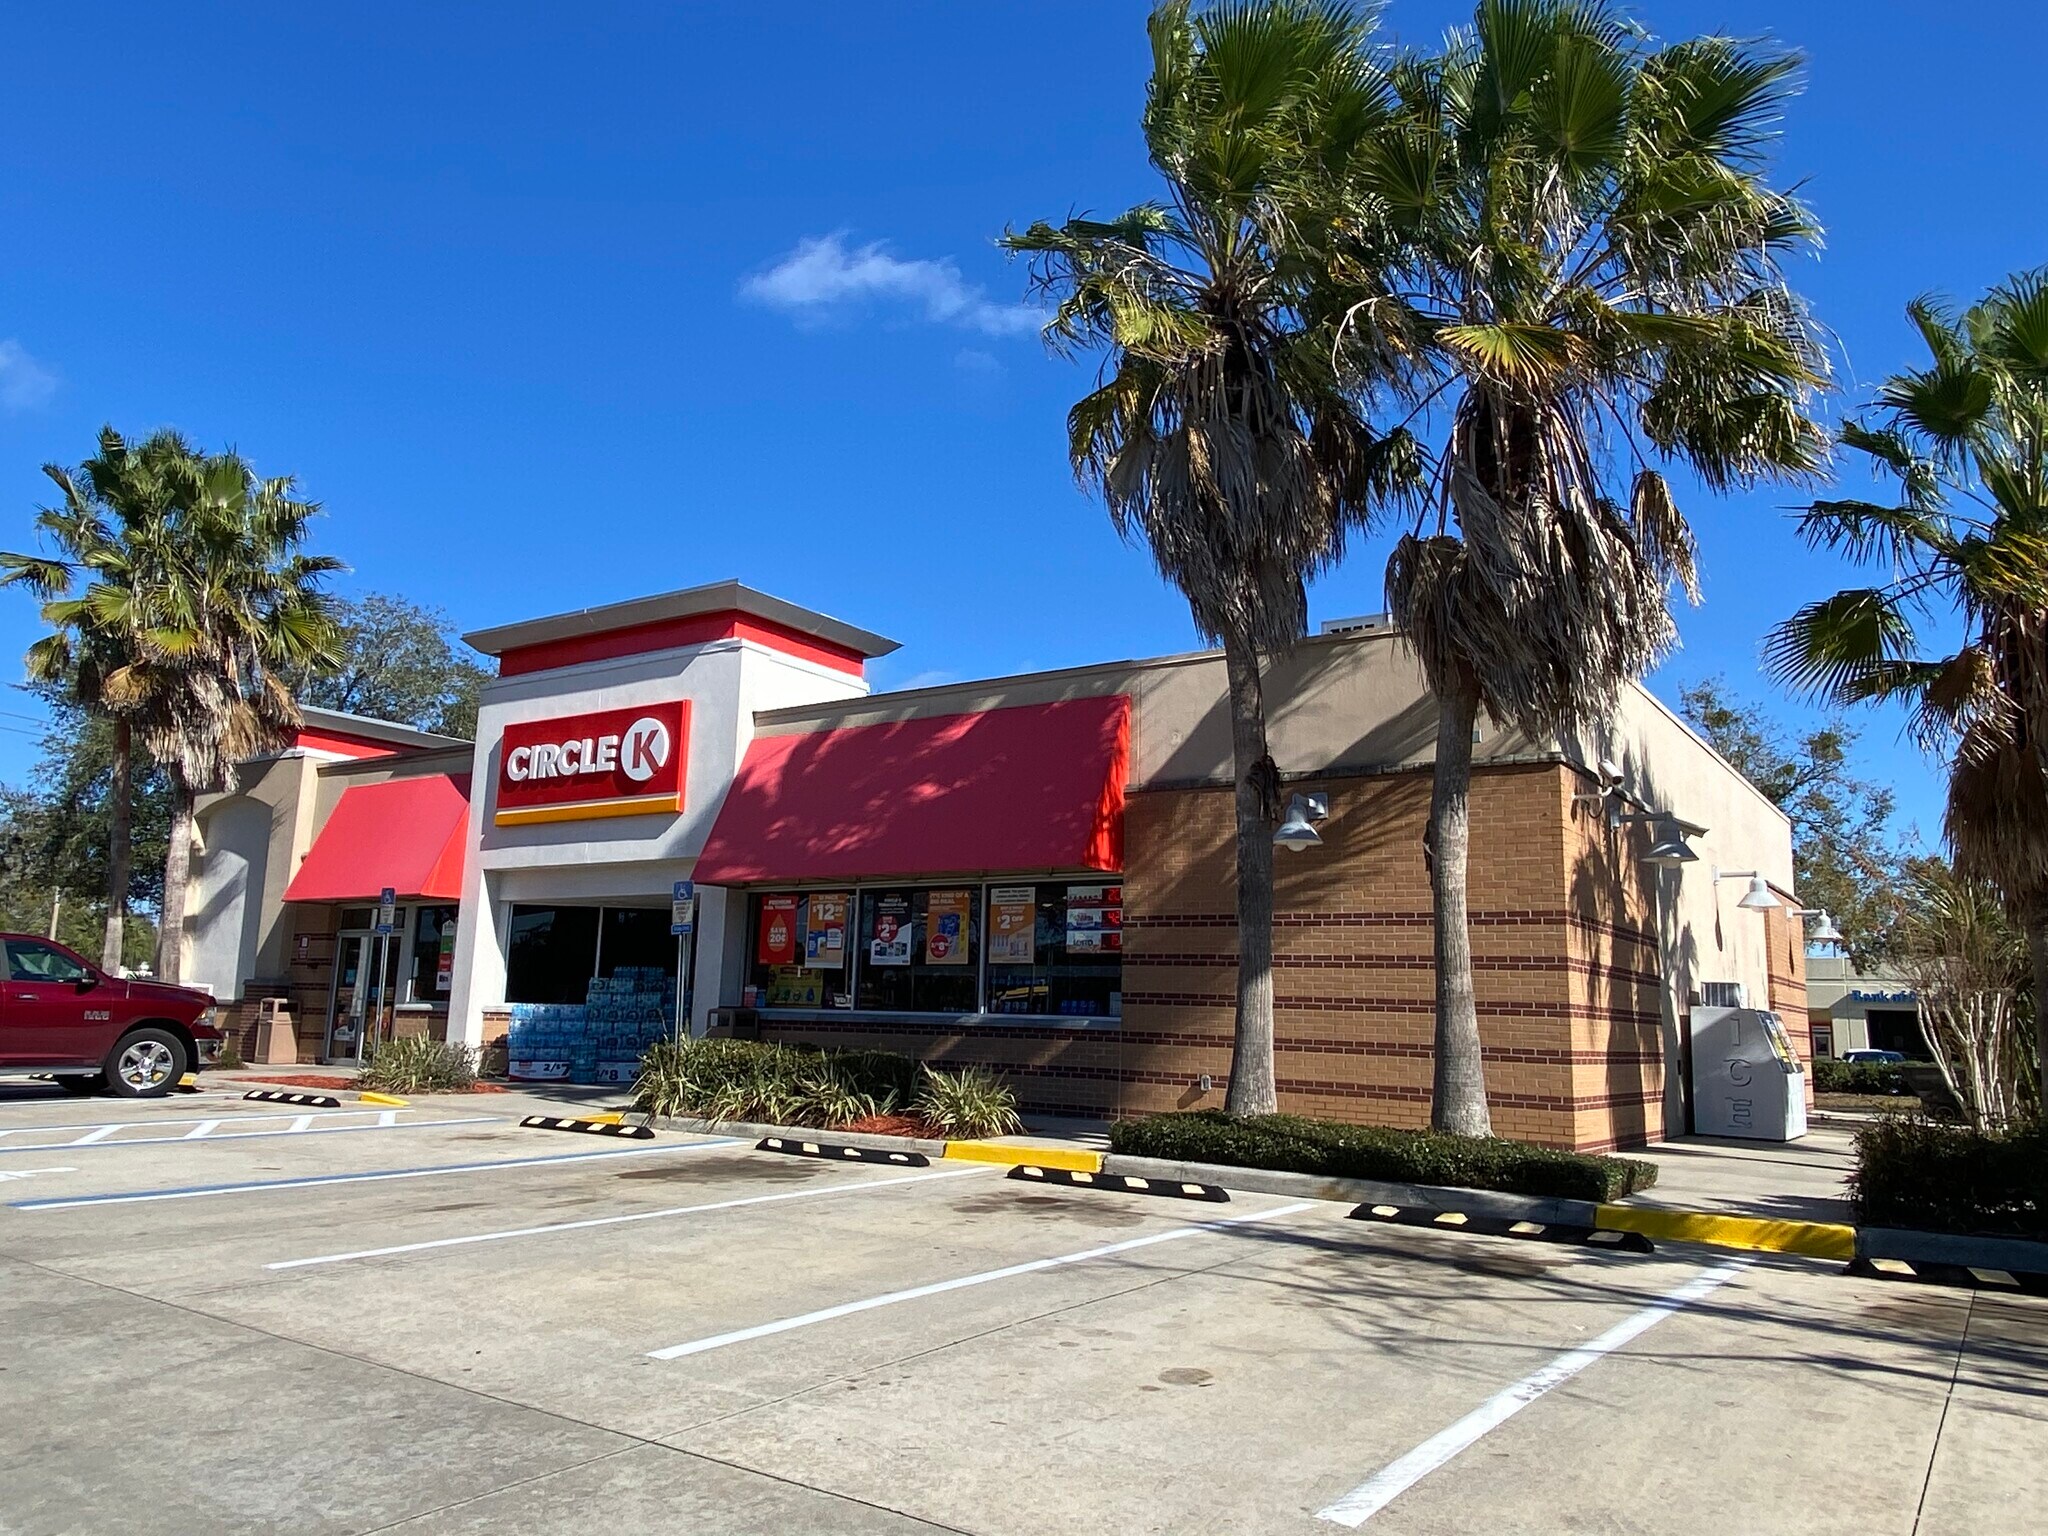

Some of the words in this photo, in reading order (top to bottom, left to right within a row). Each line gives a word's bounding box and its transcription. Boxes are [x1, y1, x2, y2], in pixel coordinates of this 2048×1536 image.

[507, 735, 619, 782] CIRCLE
[631, 728, 664, 777] K
[770, 926, 787, 934] SAVE
